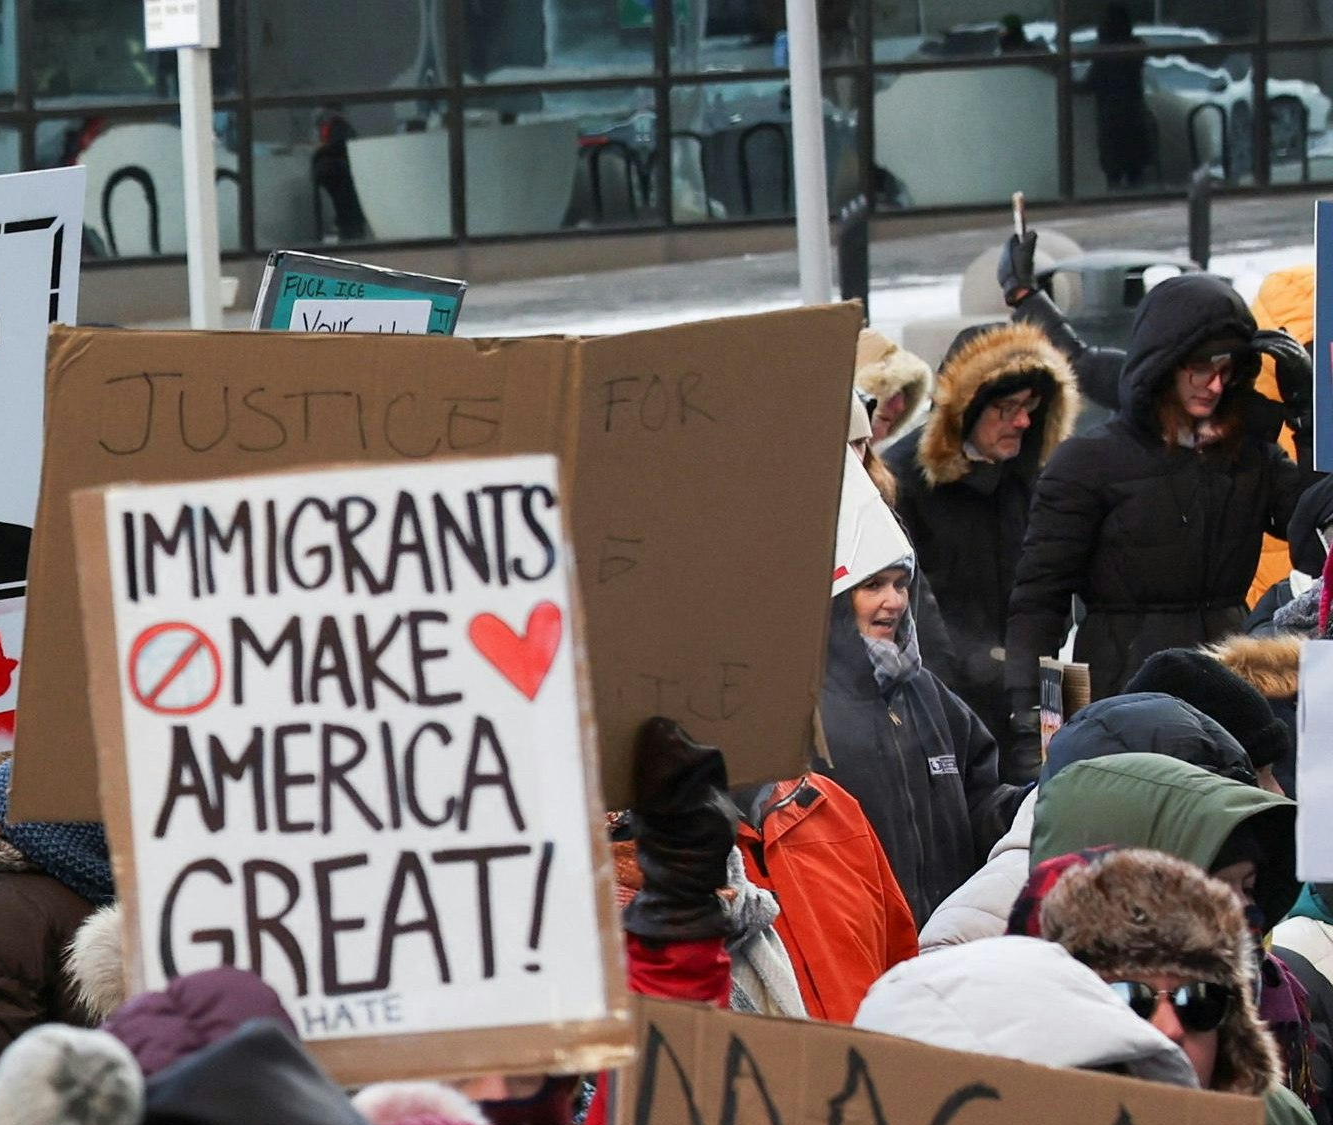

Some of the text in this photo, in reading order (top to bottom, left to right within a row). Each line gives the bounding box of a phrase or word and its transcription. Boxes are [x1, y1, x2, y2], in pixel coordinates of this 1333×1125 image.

[283, 274, 327, 299] FUCK
[99, 371, 717, 457] JUSTICE FOR
[124, 484, 558, 603] IMMIGRANTS
[232, 610, 463, 708] MAKE
[155, 716, 528, 840] AMERICA
[159, 842, 554, 999] GREAT!
